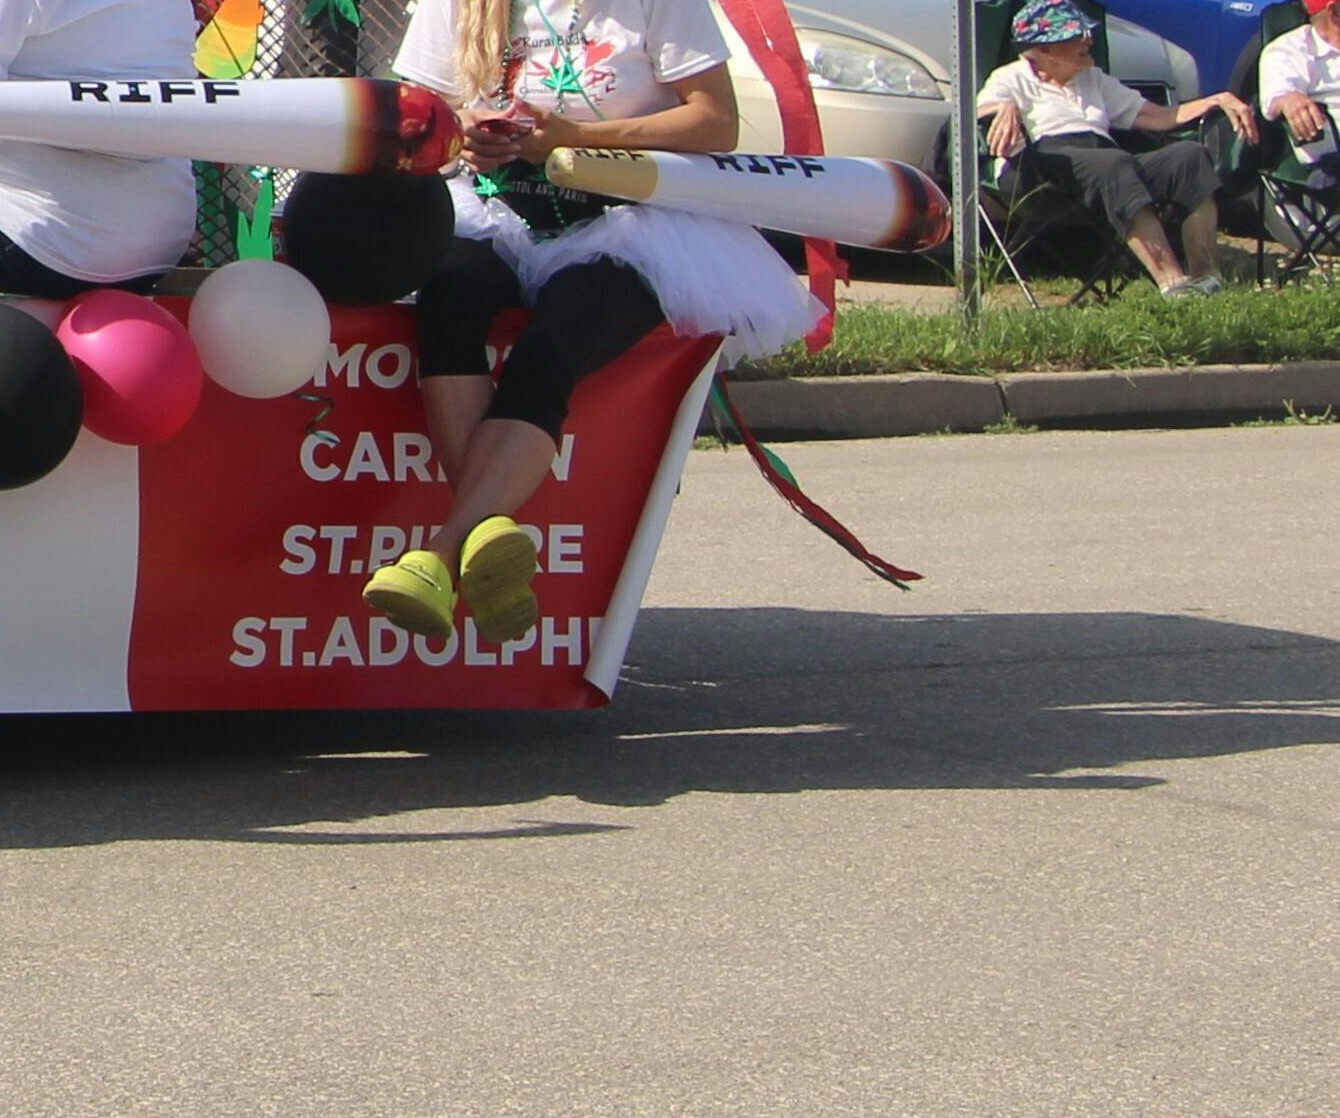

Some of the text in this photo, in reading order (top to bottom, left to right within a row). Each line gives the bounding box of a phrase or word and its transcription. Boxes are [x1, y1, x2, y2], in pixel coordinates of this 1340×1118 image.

[69, 81, 240, 104] RIFF
[707, 153, 826, 179] RIFF
[229, 614, 606, 668] ST.ADOLPH
